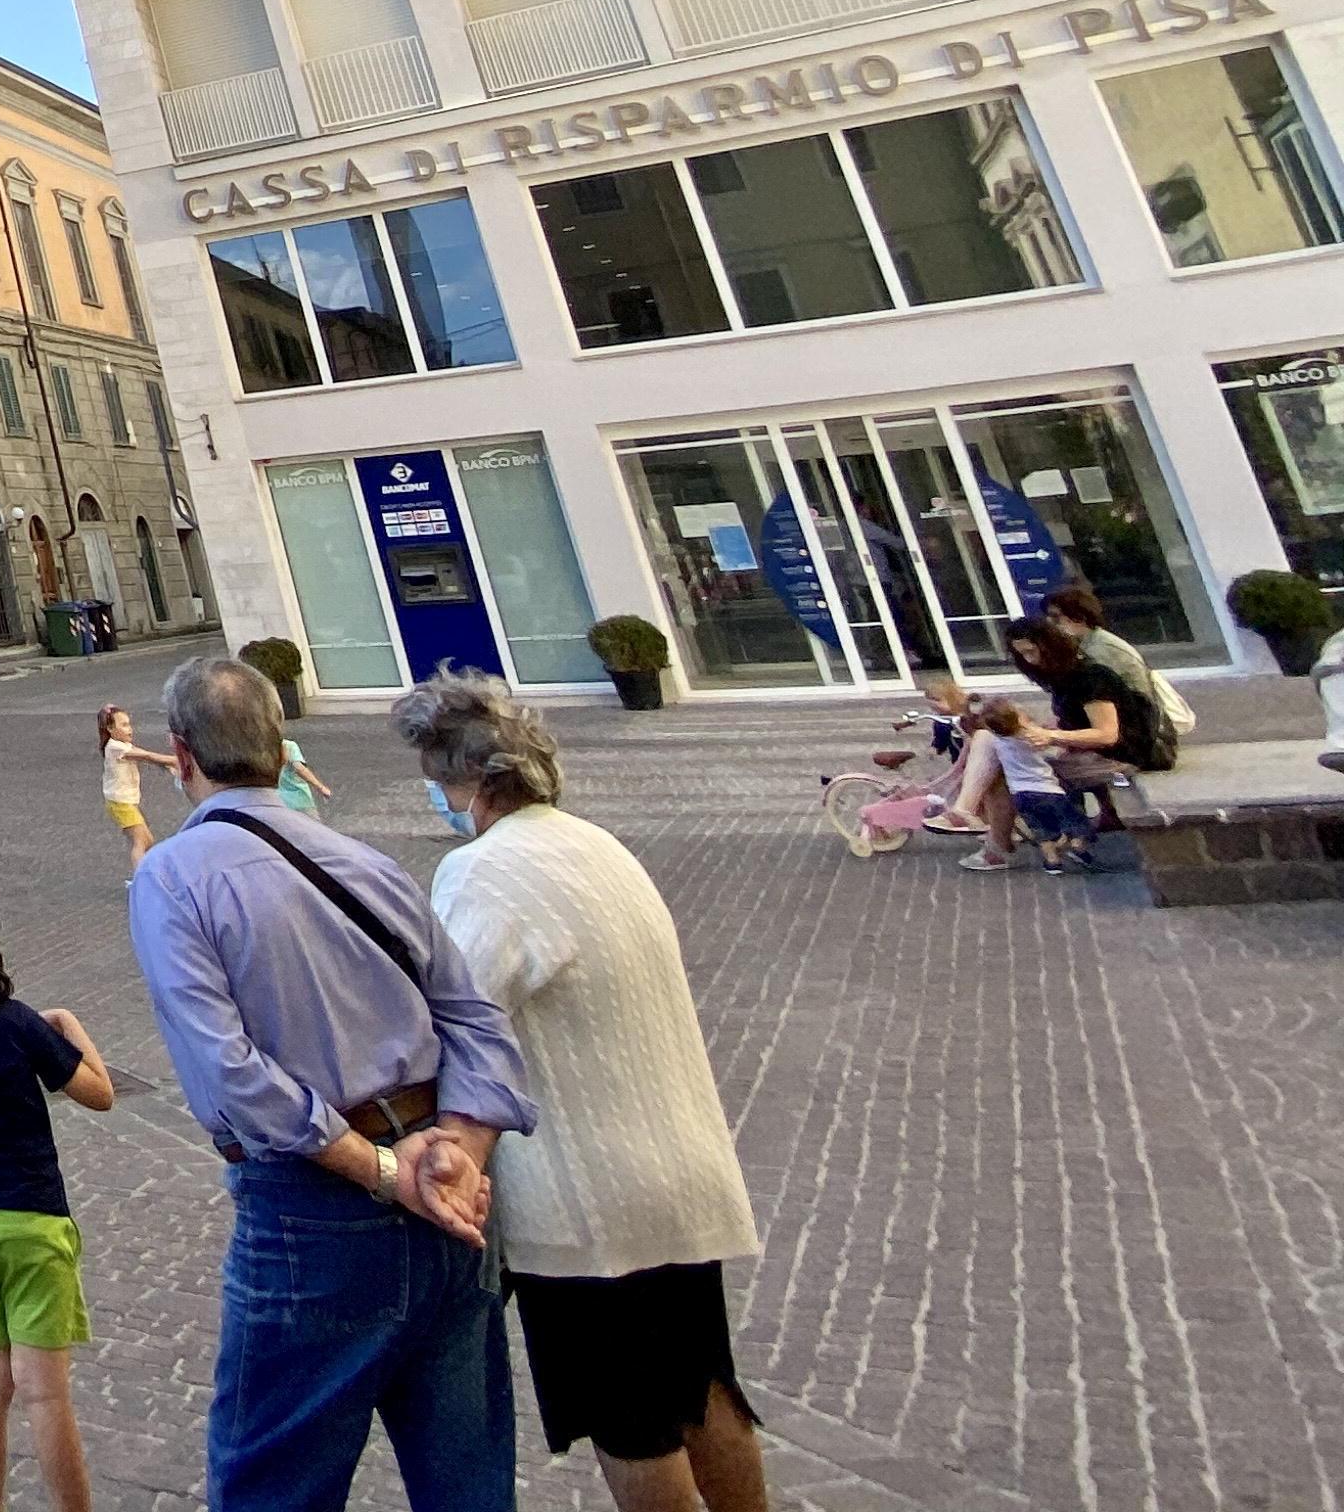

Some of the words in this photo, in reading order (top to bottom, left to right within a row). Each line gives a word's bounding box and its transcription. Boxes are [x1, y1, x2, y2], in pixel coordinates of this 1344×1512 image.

[182, 157, 378, 224] CASSA
[405, 139, 470, 184] DI
[493, 54, 900, 166] RISPARMIO
[940, 31, 1025, 81] DI
[1256, 368, 1325, 387] BANCO
[461, 457, 511, 471] BANCO
[512, 453, 541, 467] BPM
[273, 474, 317, 489] BANCO
[318, 472, 344, 485] BPM
